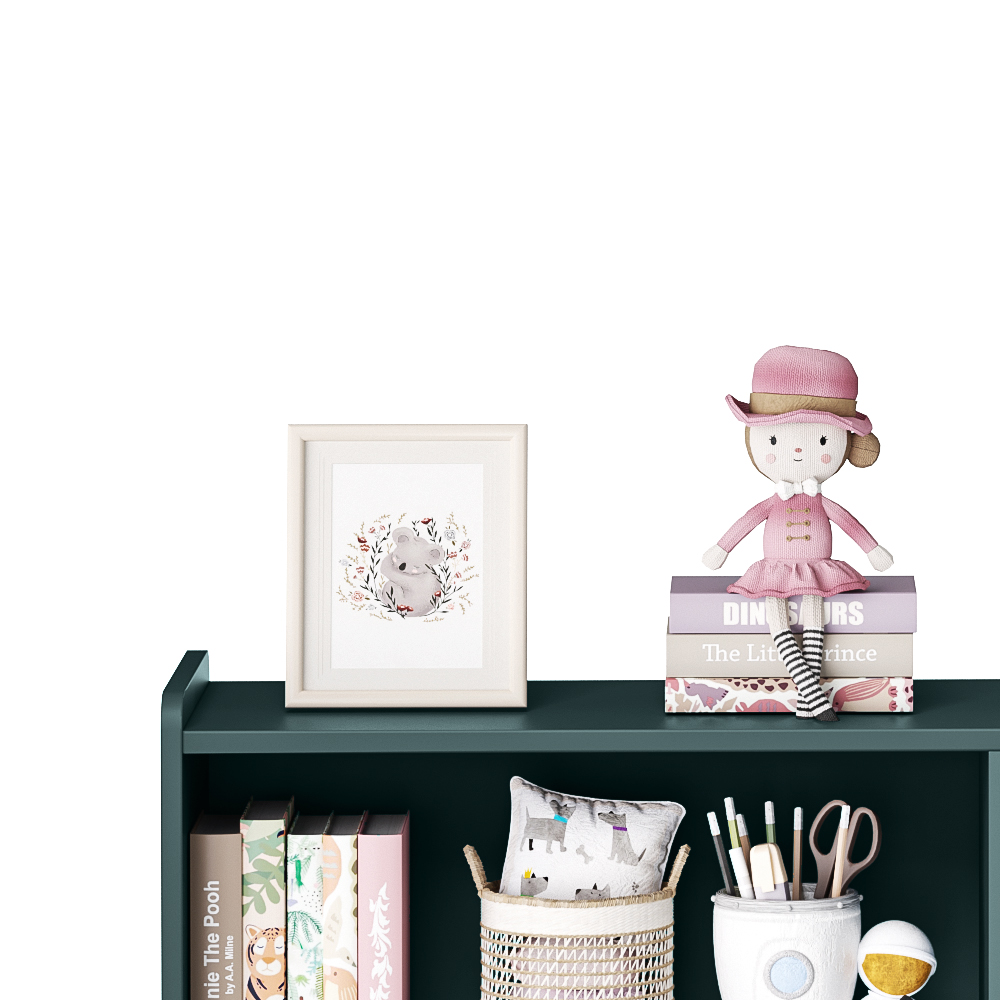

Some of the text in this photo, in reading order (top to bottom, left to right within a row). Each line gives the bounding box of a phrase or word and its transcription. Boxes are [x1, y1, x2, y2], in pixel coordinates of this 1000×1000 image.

[723, 601, 864, 626] DINSRS
[702, 642, 877, 662] The Litt rince
[203, 881, 220, 927] Pooh
[203, 933, 220, 966] The
[225, 935, 236, 995] by A.A. Milne
